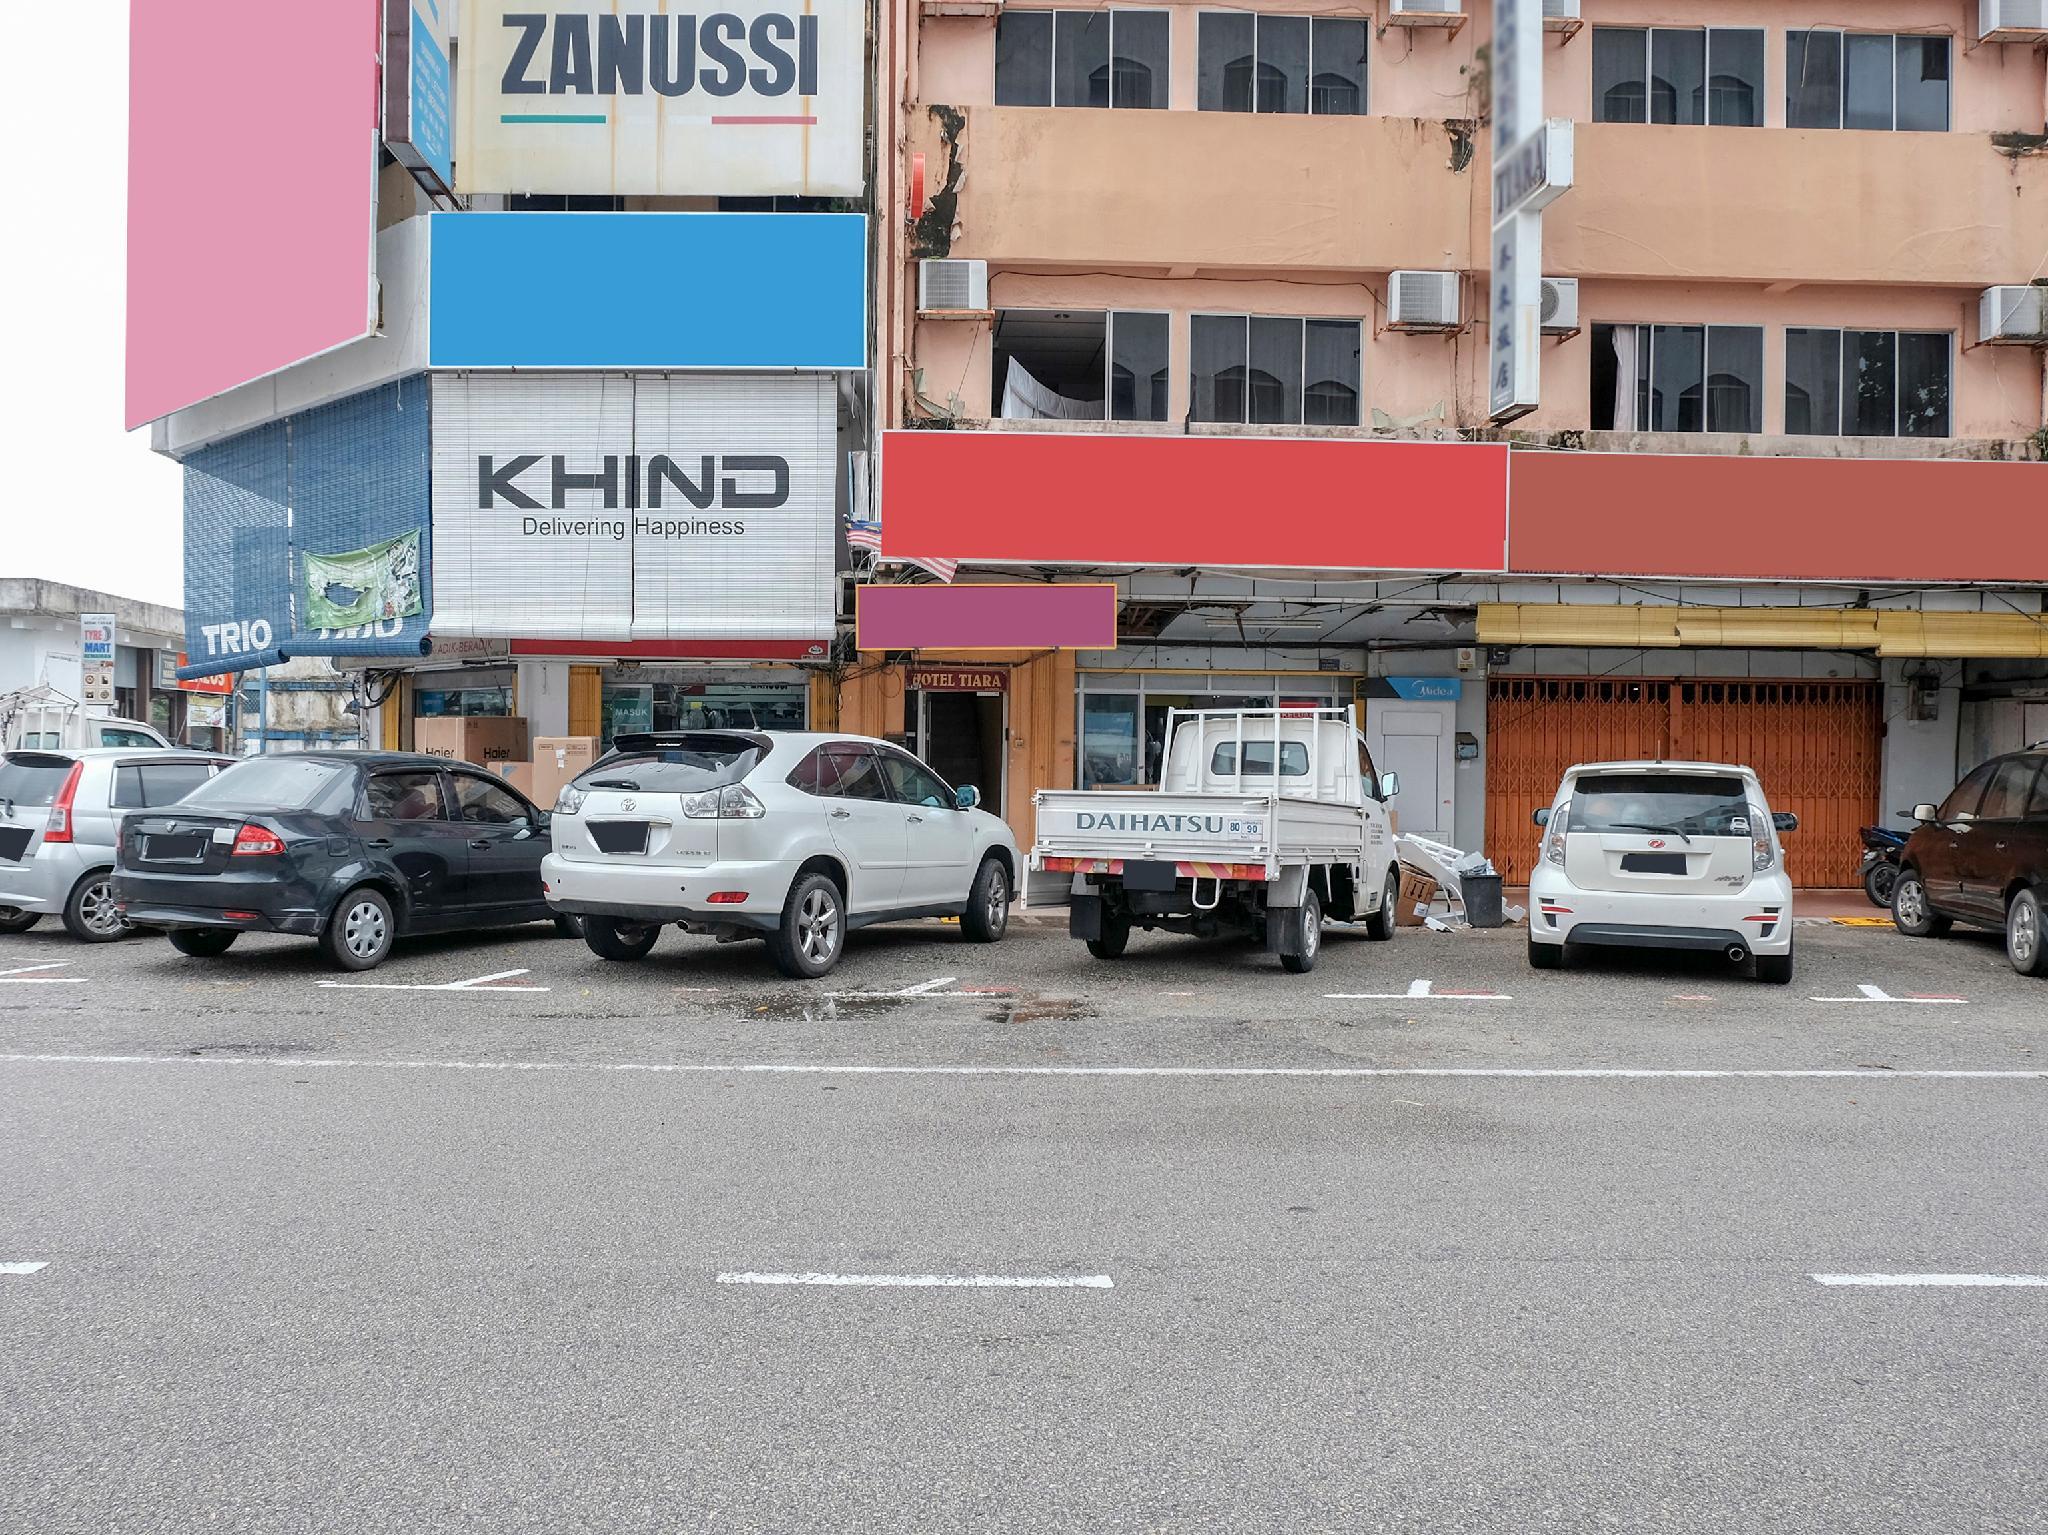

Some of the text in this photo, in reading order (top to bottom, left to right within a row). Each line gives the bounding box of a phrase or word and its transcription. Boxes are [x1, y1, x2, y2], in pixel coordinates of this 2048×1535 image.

[501, 13, 818, 97] ZANUSSI
[478, 455, 790, 509] KHIND
[523, 517, 745, 539] Delivering Happiness
[84, 630, 103, 640] TYRE
[201, 619, 273, 655] TRIO
[84, 642, 111, 653] MART
[912, 673, 1001, 688] HOTEL TIARA
[1419, 685, 1453, 697] Midea
[615, 708, 648, 717] MASUK
[483, 747, 510, 759] Haier
[1076, 813, 1223, 833] DAIHATSU
[1230, 822, 1240, 832] 80
[1246, 824, 1257, 833] 90
